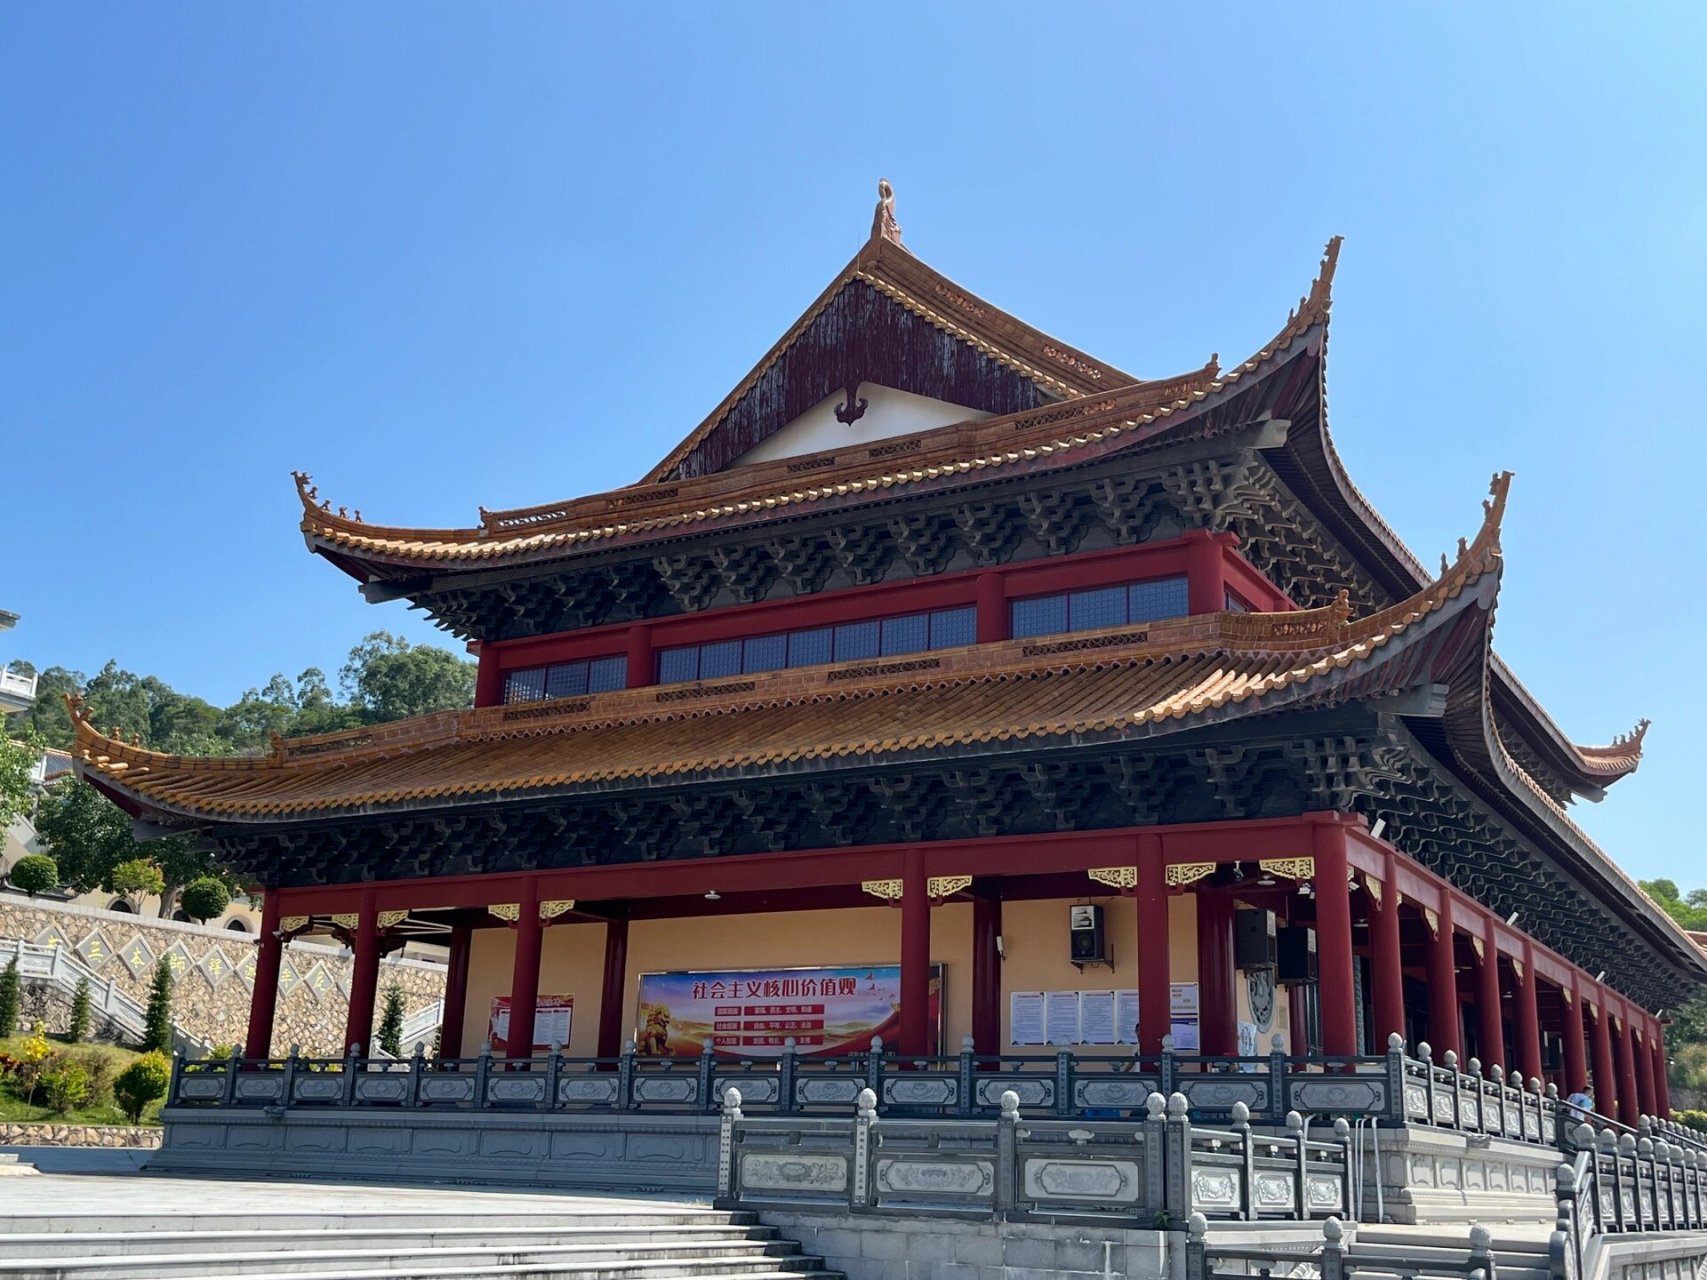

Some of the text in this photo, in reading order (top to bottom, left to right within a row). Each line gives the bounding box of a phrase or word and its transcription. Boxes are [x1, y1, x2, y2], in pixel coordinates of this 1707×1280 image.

[692, 978, 857, 999] 社会主义核心价值观
